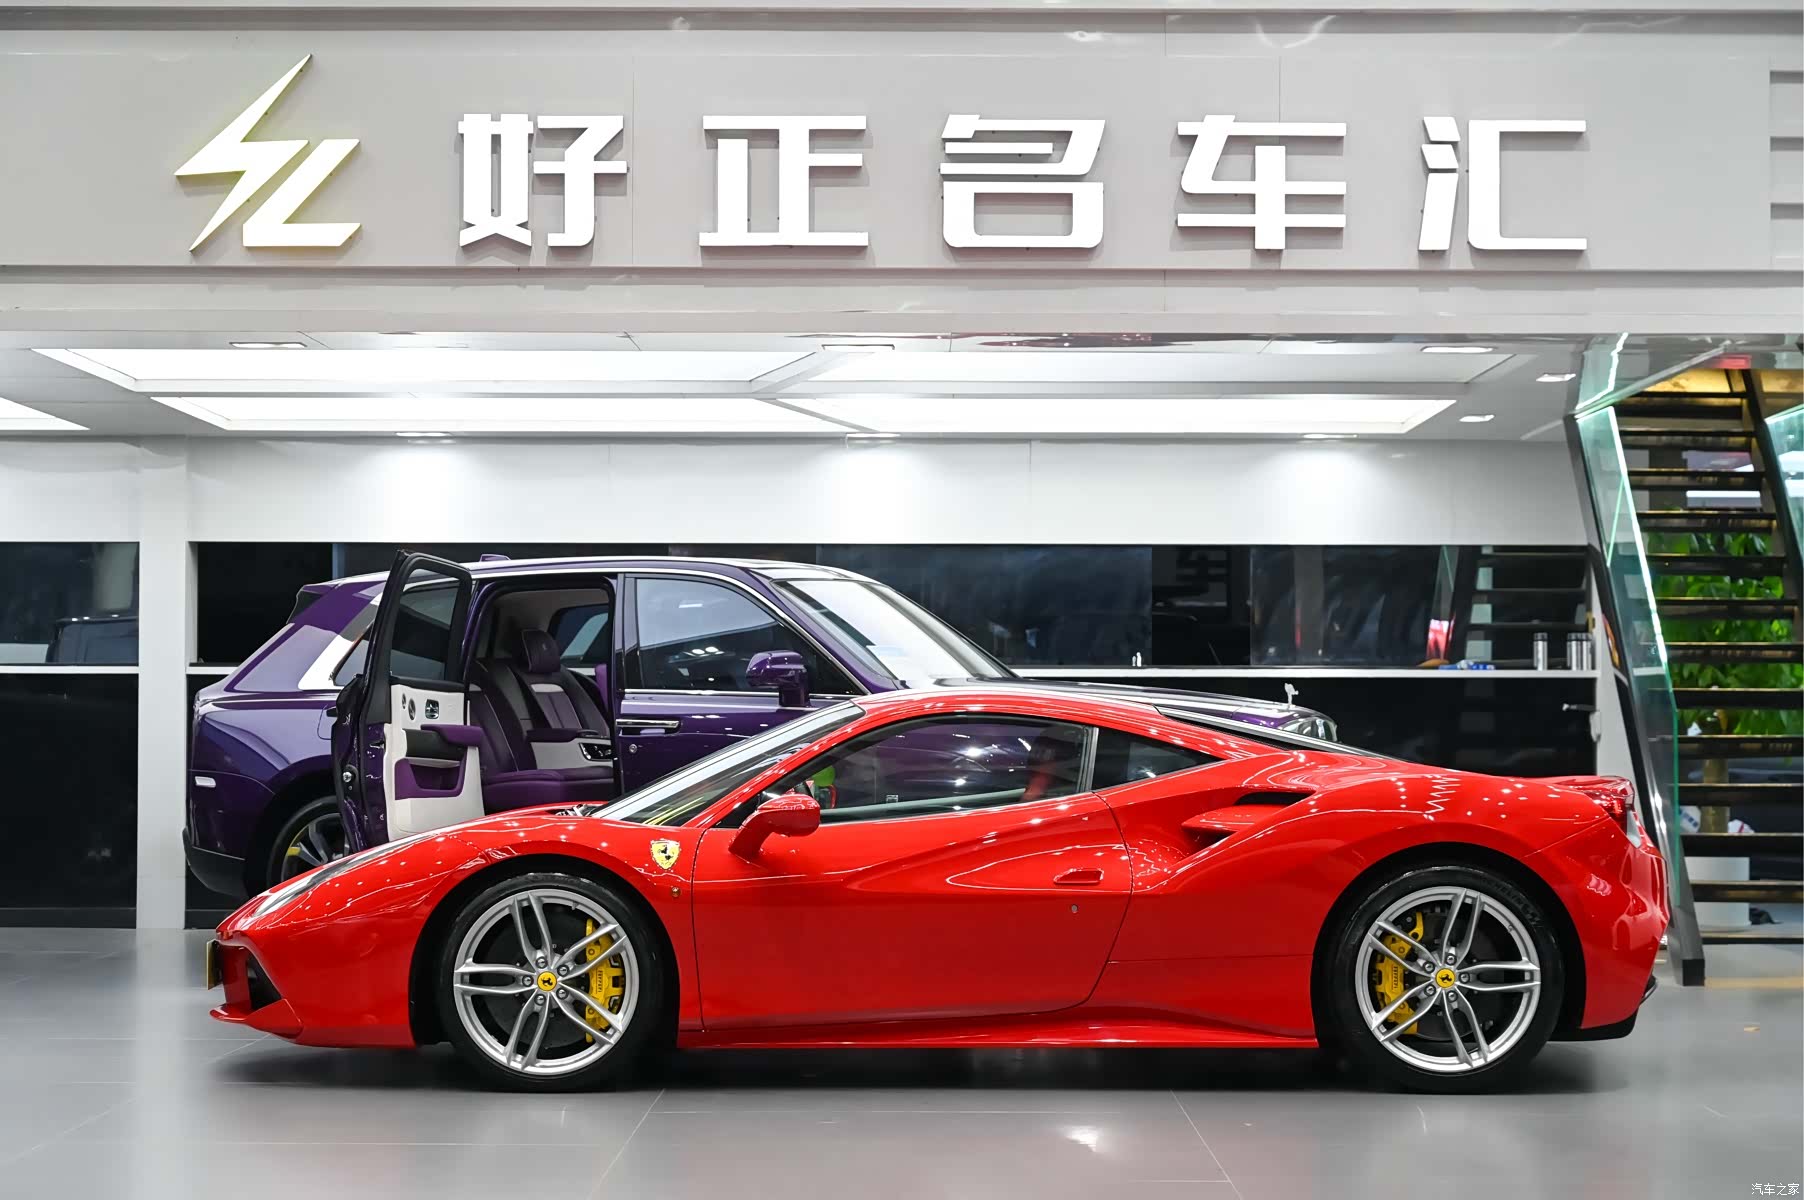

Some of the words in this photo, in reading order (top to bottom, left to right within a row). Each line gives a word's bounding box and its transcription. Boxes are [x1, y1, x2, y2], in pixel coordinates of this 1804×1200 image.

[458, 113, 1588, 250] 好正名车汇
